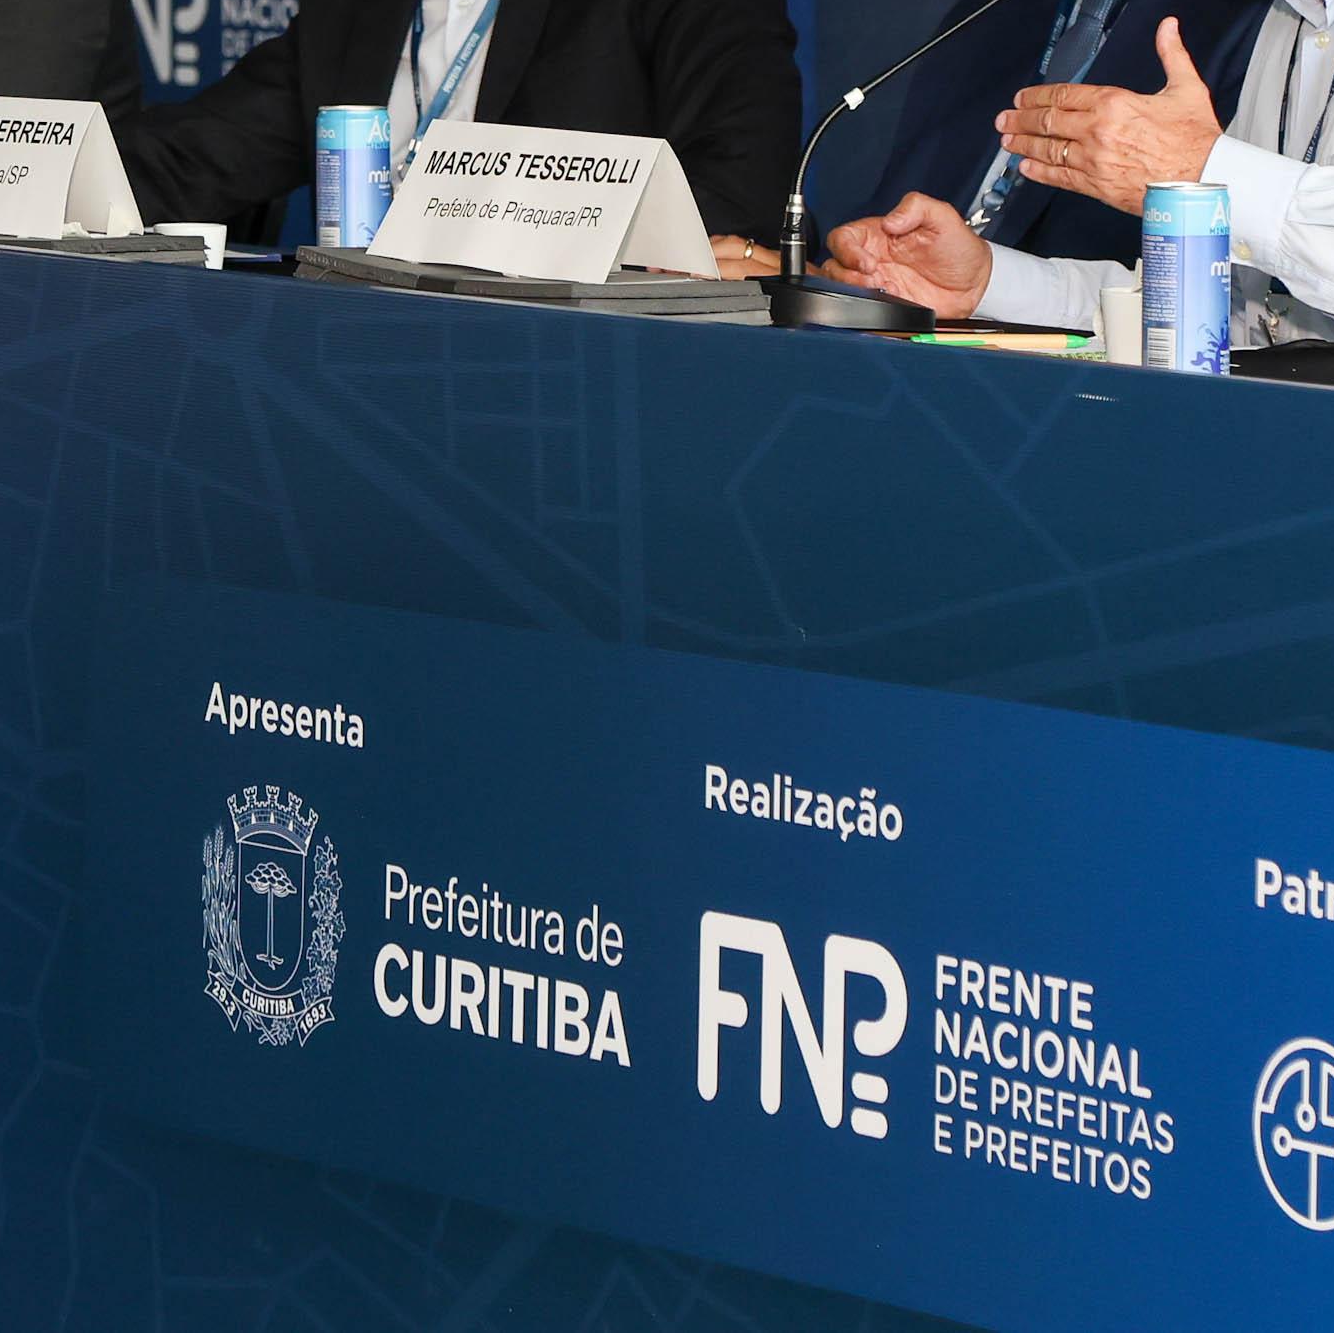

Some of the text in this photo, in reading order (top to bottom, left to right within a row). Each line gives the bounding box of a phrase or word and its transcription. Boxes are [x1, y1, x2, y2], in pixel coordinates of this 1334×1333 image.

[424, 150, 511, 176] MARCUS
[515, 153, 641, 184] TESSEROLLI
[424, 197, 603, 230] Prefeito de Piraquara/PR
[205, 682, 364, 749] Apresenta
[705, 764, 903, 844] Realização
[386, 863, 624, 968] Prefeitura de
[242, 988, 295, 1015] CURITIBA
[299, 1003, 327, 1034] 1693
[375, 942, 631, 1068] CURITIBA
[697, 910, 908, 1129] FNP
[936, 954, 1095, 1031] FRENTE
[935, 1012, 1153, 1100] NACIONAL
[935, 1066, 1175, 1155] DE PREFEITAS
[935, 1115, 1153, 1199] E PREFEITOS
